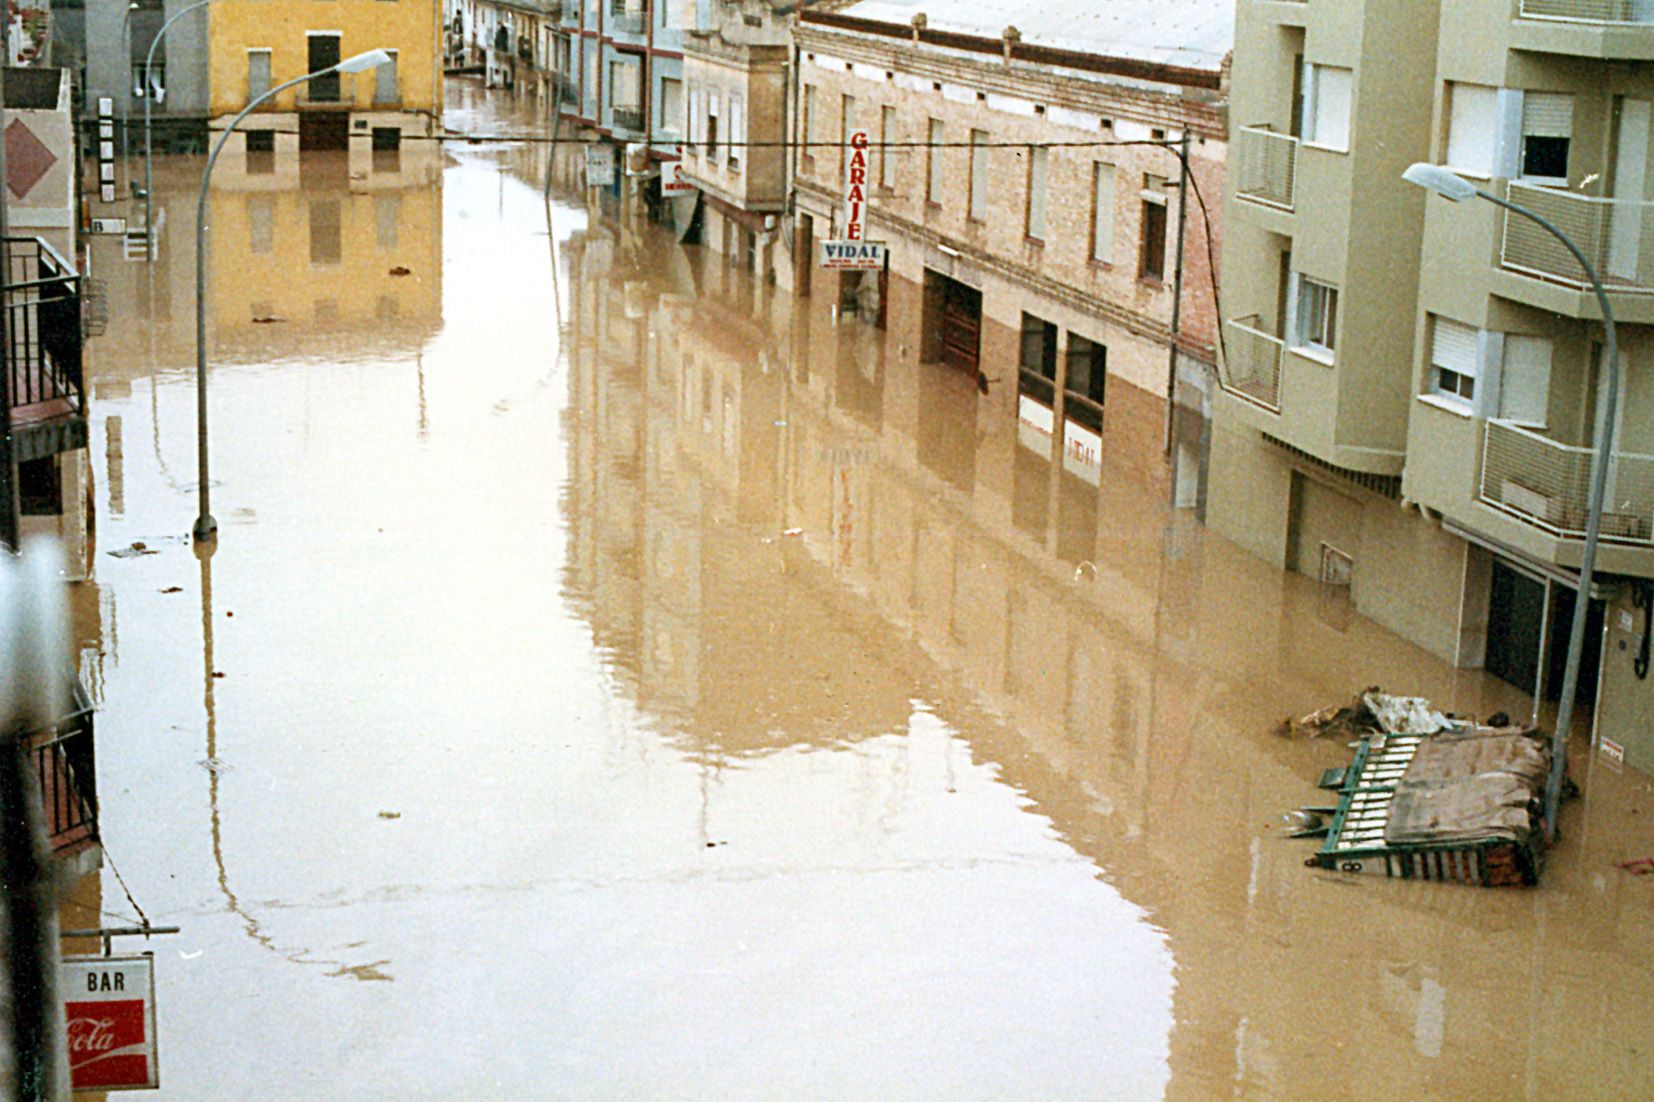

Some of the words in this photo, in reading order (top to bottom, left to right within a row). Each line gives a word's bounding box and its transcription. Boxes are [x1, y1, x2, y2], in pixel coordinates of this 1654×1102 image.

[847, 131, 868, 241] GARAJE
[825, 244, 881, 258] VIDAL
[87, 971, 125, 992] BAR
